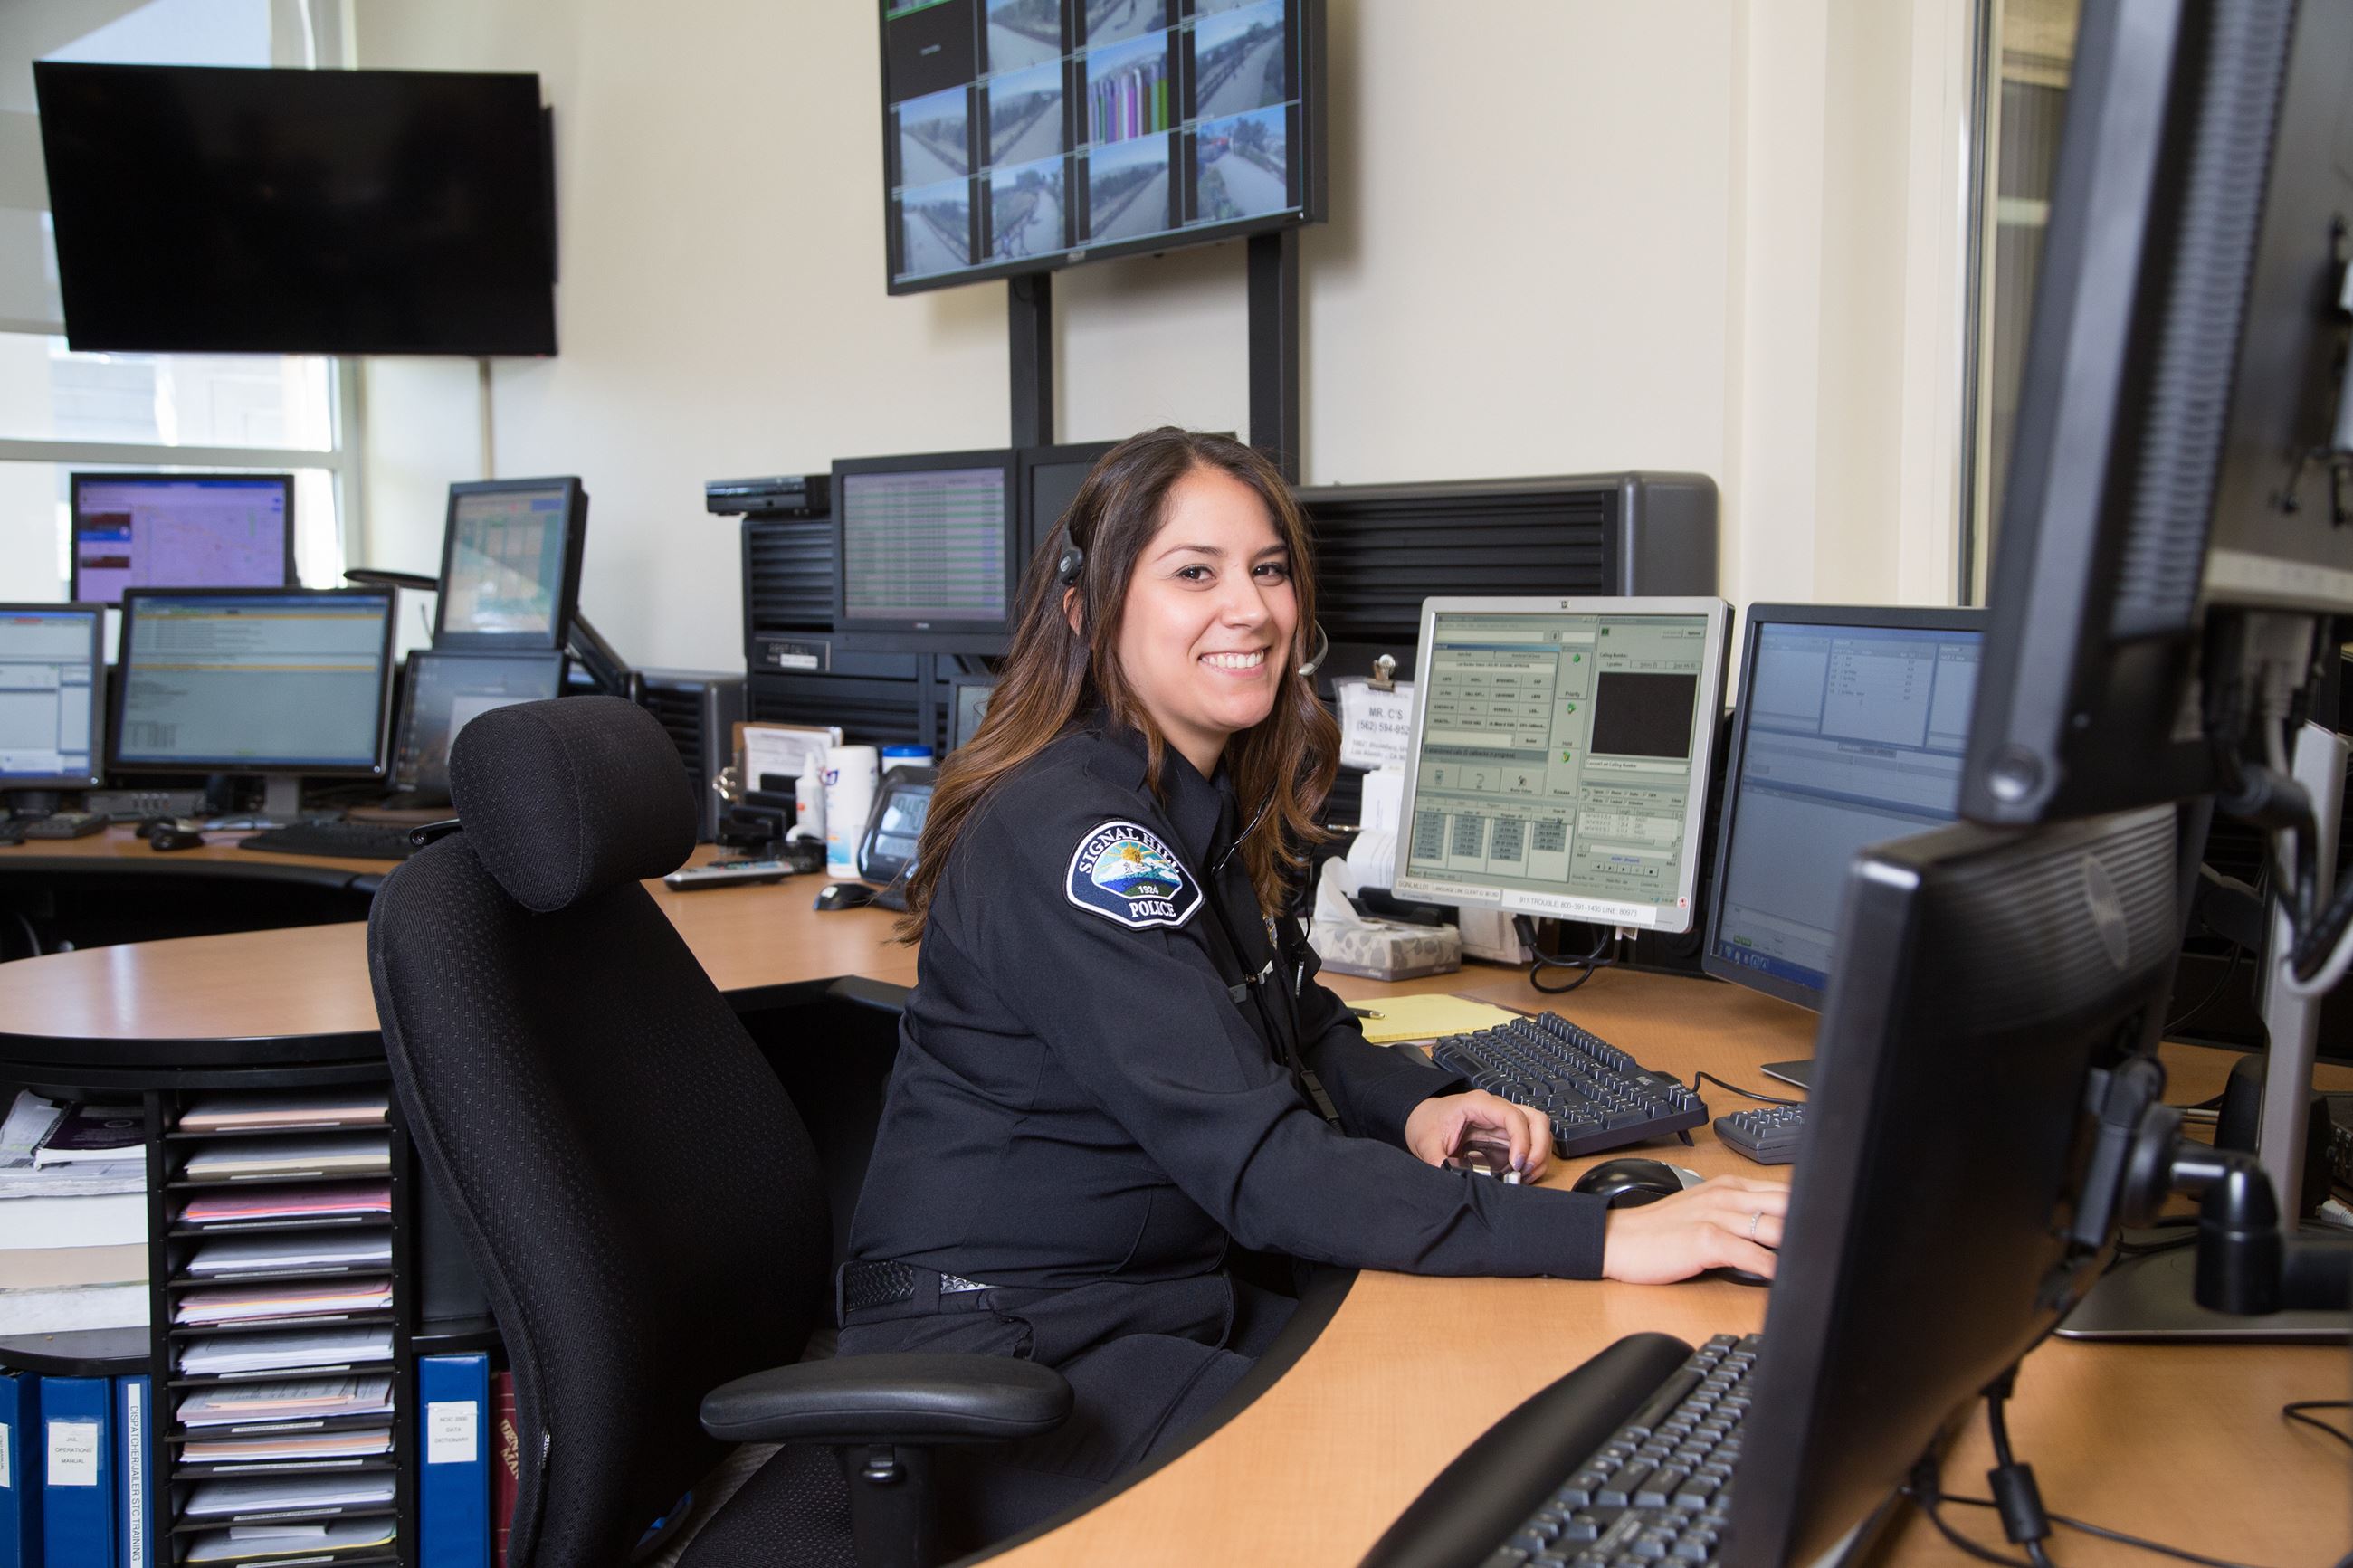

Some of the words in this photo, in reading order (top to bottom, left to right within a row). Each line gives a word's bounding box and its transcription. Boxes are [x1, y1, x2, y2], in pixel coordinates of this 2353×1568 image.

[1379, 722, 1410, 735] 594-952
[1079, 827, 1139, 874] SIGNAL
[1142, 832, 1181, 874] HILL
[1138, 885, 1159, 895] 1924
[1129, 899, 1176, 918] POLICE
[1531, 897, 1558, 908] TROUBLE:
[130, 1406, 140, 1496] DISPATCHER/JAILER
[131, 1498, 140, 1516] STC
[132, 1518, 141, 1561] TRAINING
